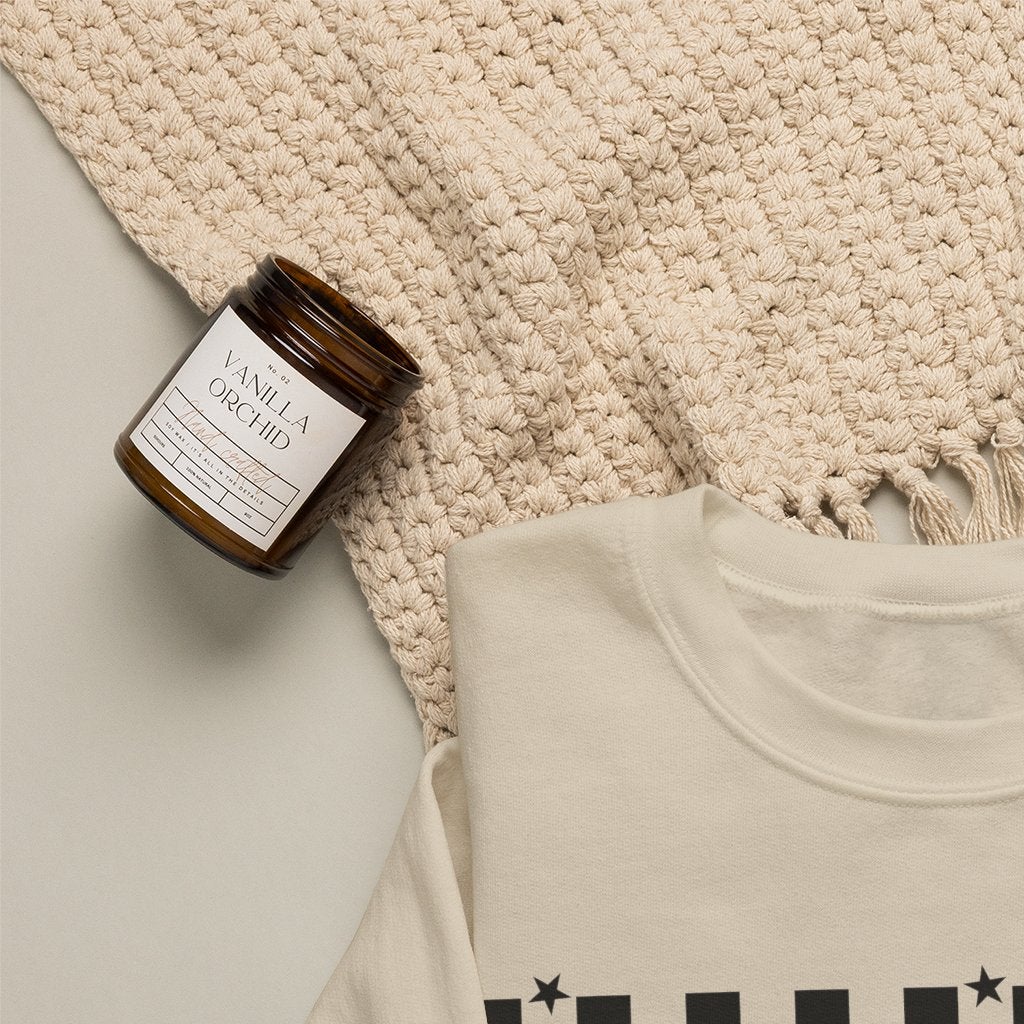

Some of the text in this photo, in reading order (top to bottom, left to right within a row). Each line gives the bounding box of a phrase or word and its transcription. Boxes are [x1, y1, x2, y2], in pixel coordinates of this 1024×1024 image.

[224, 349, 309, 434] VANILLA
[267, 363, 291, 386] No. 02
[208, 377, 291, 450] ORCHID
[190, 446, 202, 458] IT'S
[203, 457, 214, 469] ALL
[215, 468, 223, 476] IN
[225, 475, 237, 487] THE
[238, 486, 264, 506] DETAILS
